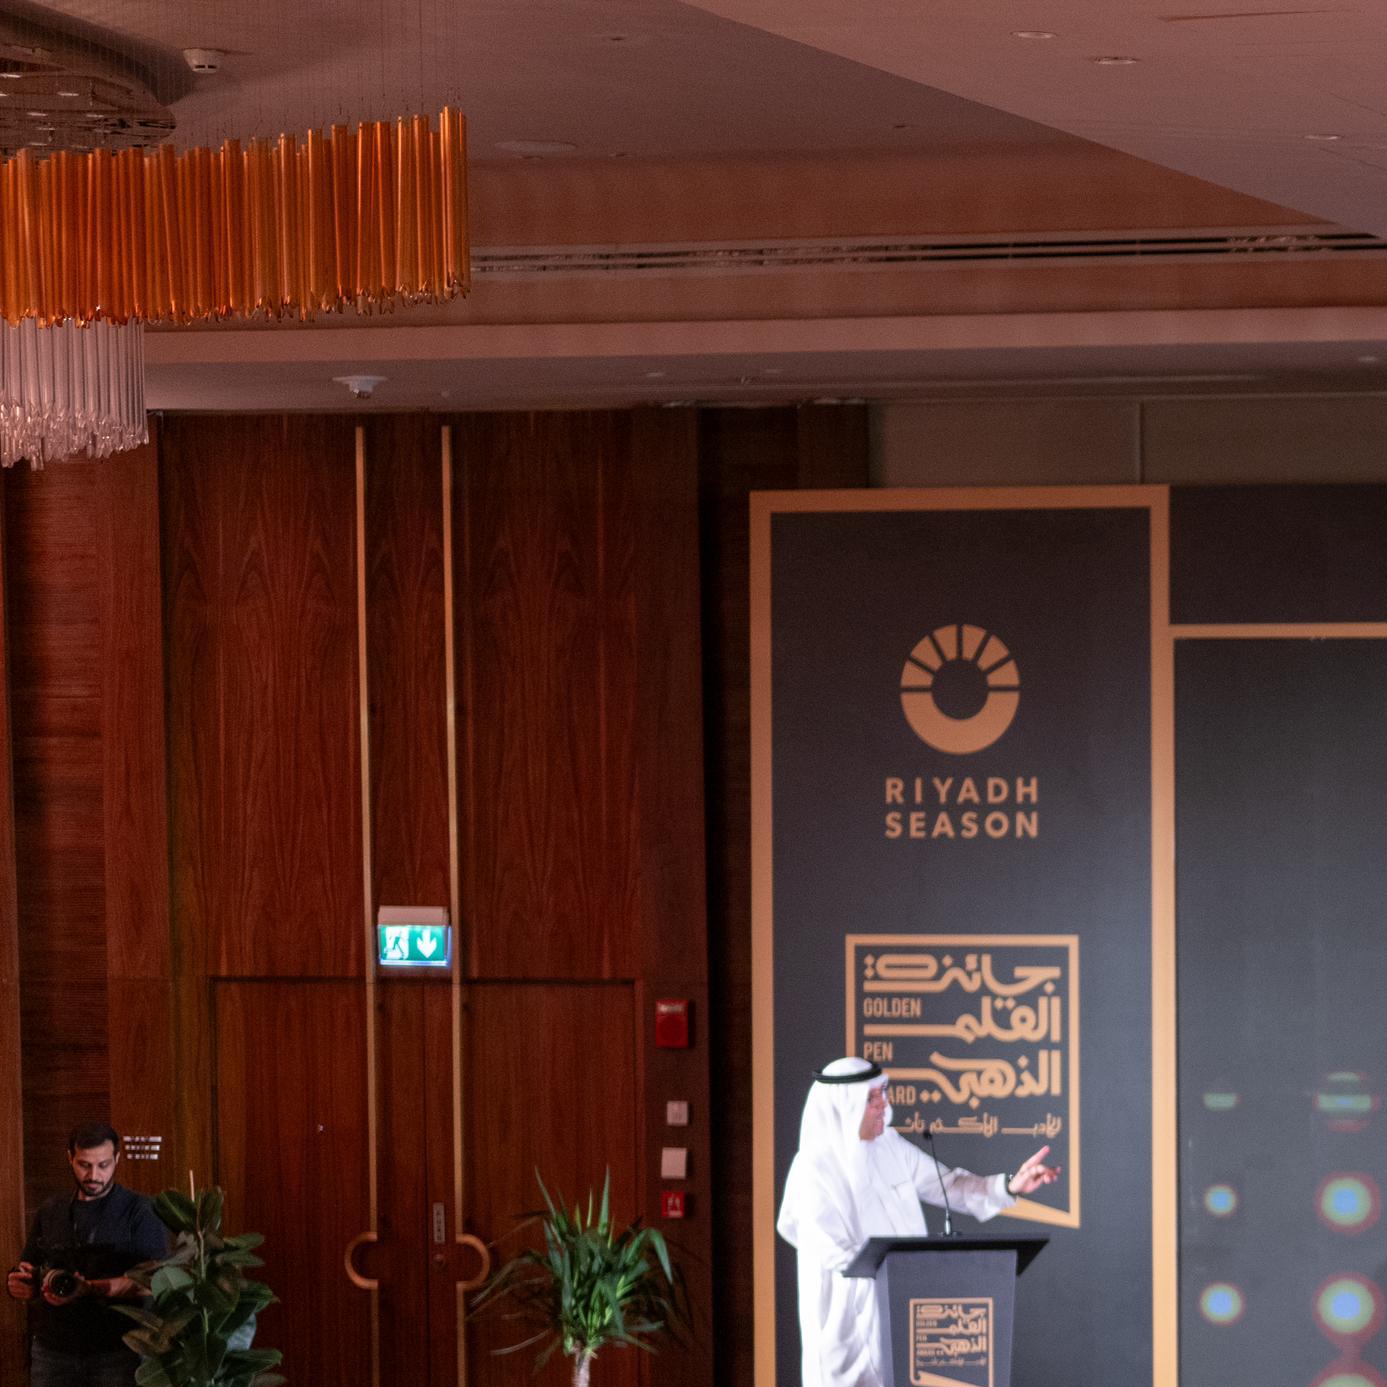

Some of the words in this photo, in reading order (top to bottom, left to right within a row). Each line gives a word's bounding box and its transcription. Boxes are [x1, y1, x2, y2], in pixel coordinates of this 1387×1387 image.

[885, 776, 1038, 804] RIYADH
[885, 811, 1039, 839] SEASON
[863, 997, 922, 1017] GOLDEN
[863, 1041, 893, 1062] PEN
